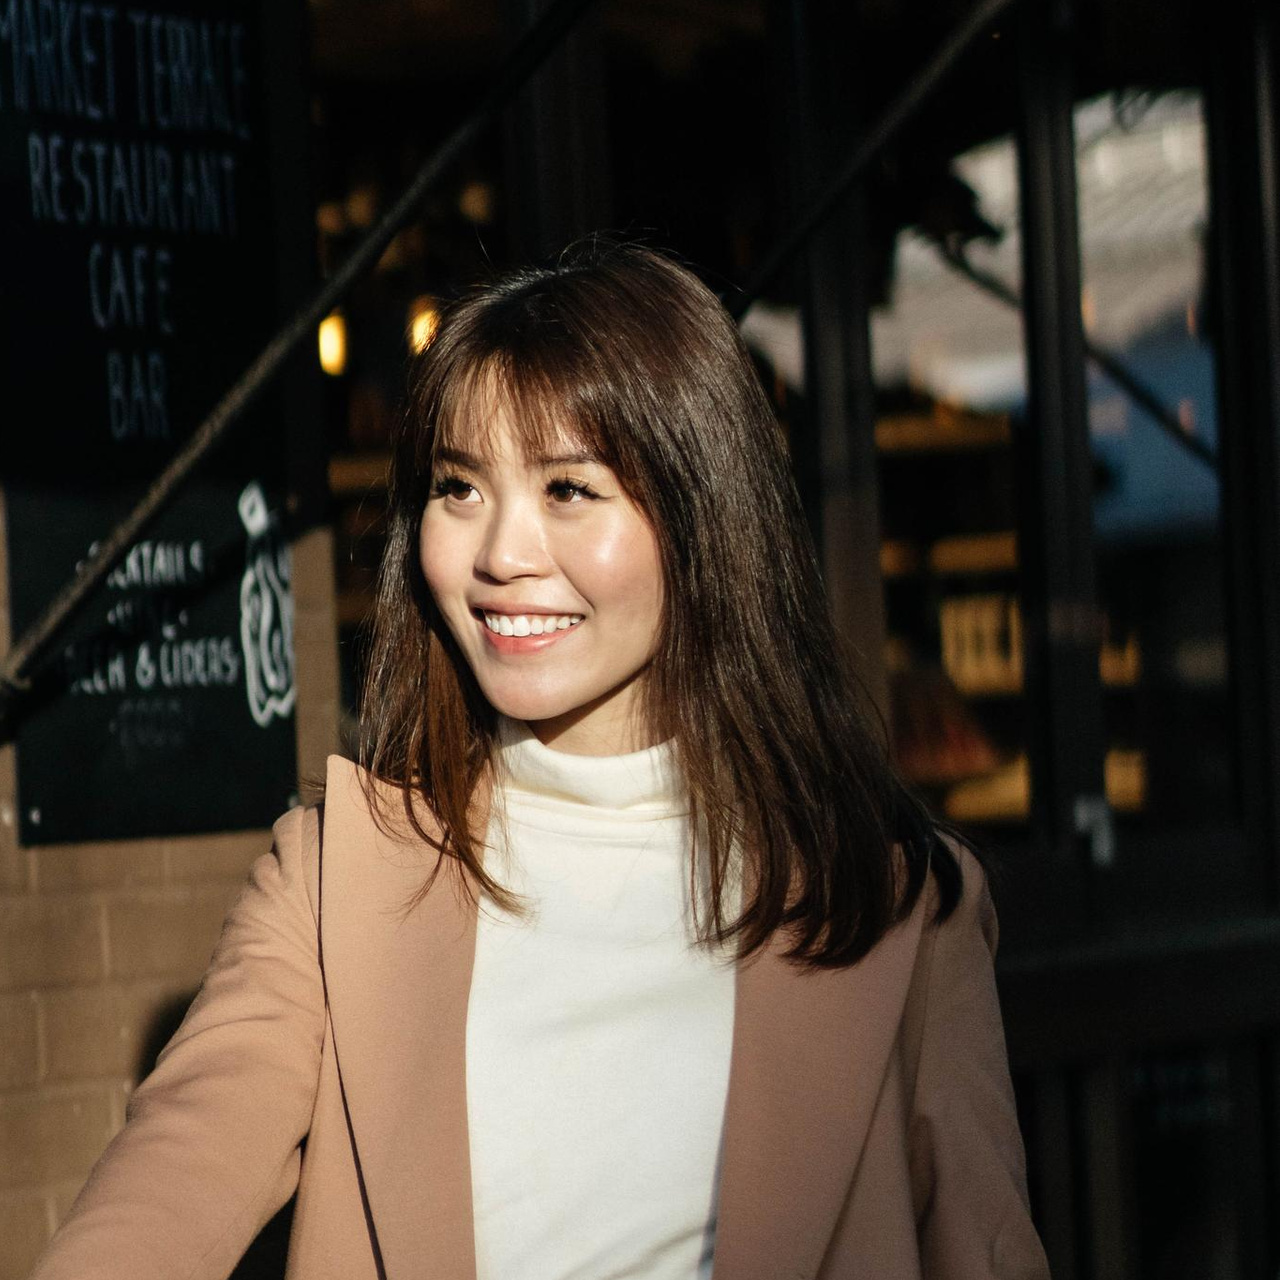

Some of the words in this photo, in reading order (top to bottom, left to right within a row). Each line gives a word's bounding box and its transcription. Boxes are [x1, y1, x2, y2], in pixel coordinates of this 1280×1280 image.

[125, 8, 252, 142] TERRACE
[26, 131, 239, 238] RESTAURANT
[88, 242, 175, 335] CAFE
[106, 349, 171, 439] BAR
[159, 637, 240, 688] CIDERS
